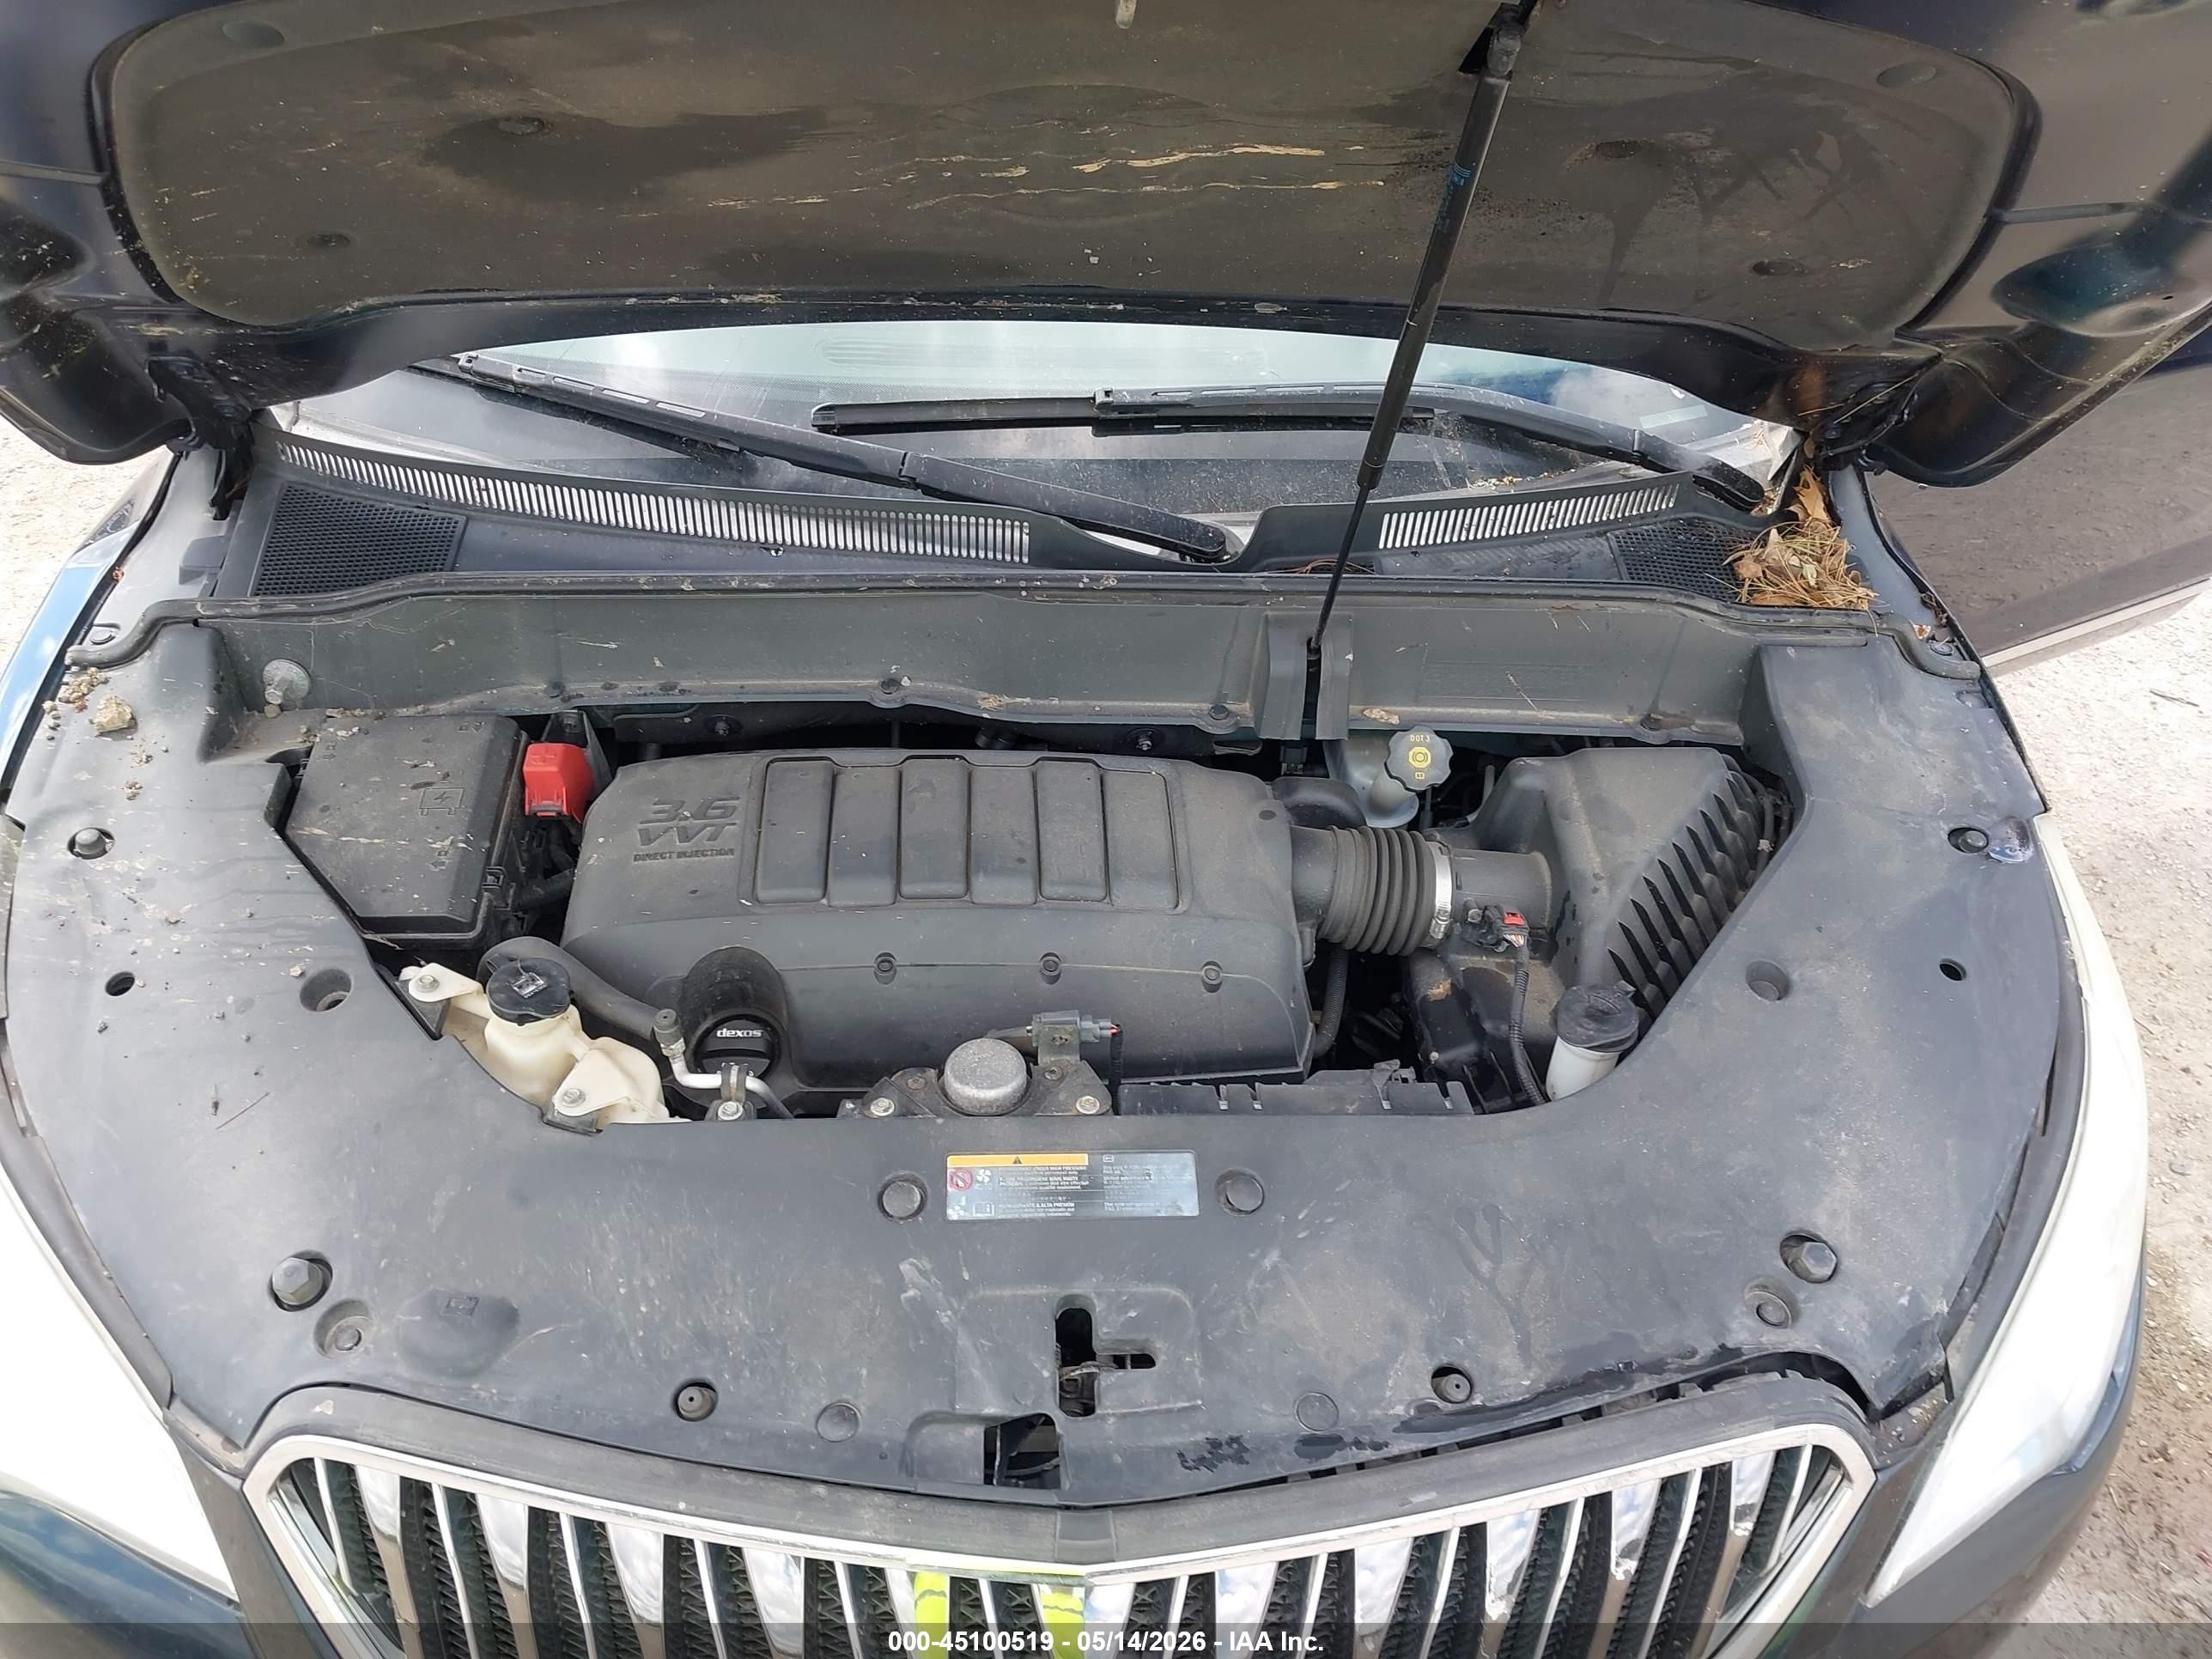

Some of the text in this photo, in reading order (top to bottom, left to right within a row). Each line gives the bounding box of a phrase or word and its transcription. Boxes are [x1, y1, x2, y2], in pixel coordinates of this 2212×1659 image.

[1410, 734, 1424, 743] DOT
[639, 796, 740, 824] 3.6
[638, 822, 738, 846] VVT
[634, 848, 735, 862] DIRECT INJECTION
[716, 1028, 763, 1037] dexos
